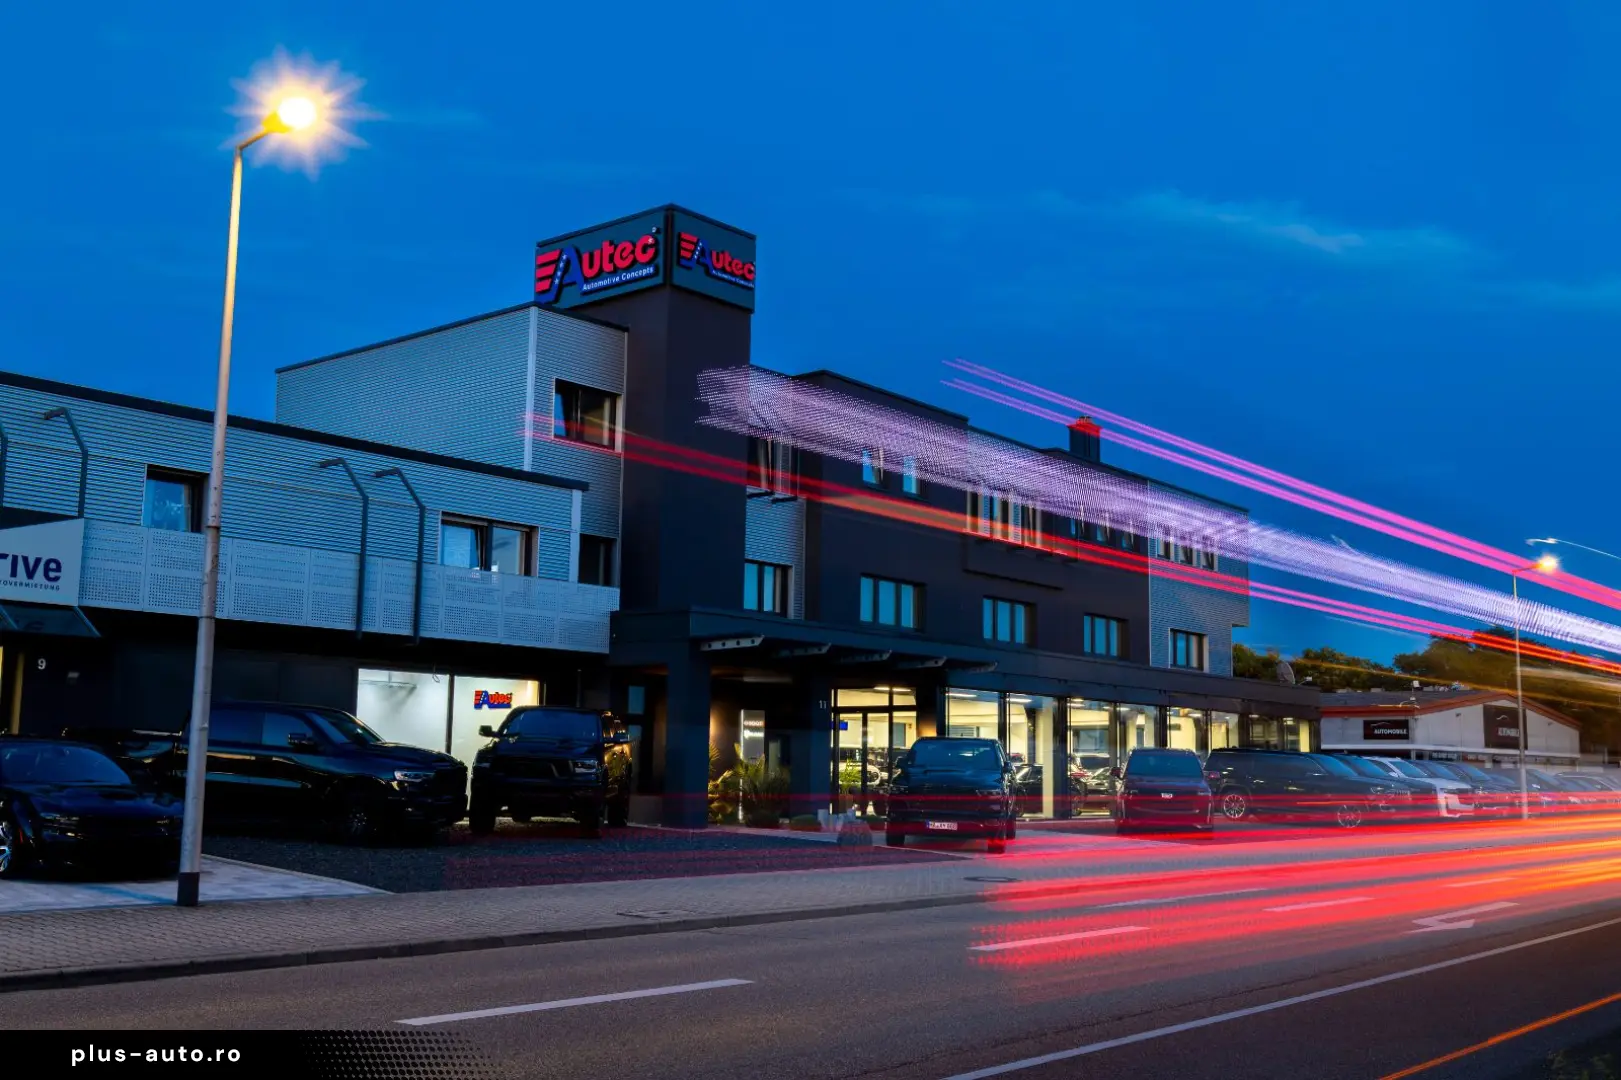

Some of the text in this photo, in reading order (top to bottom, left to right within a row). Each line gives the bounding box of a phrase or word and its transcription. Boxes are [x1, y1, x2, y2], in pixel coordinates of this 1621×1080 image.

[535, 234, 656, 302] Autec
[680, 232, 755, 281] Autec
[583, 265, 655, 291] Automotive Concepts
[37, 658, 46, 670] 9
